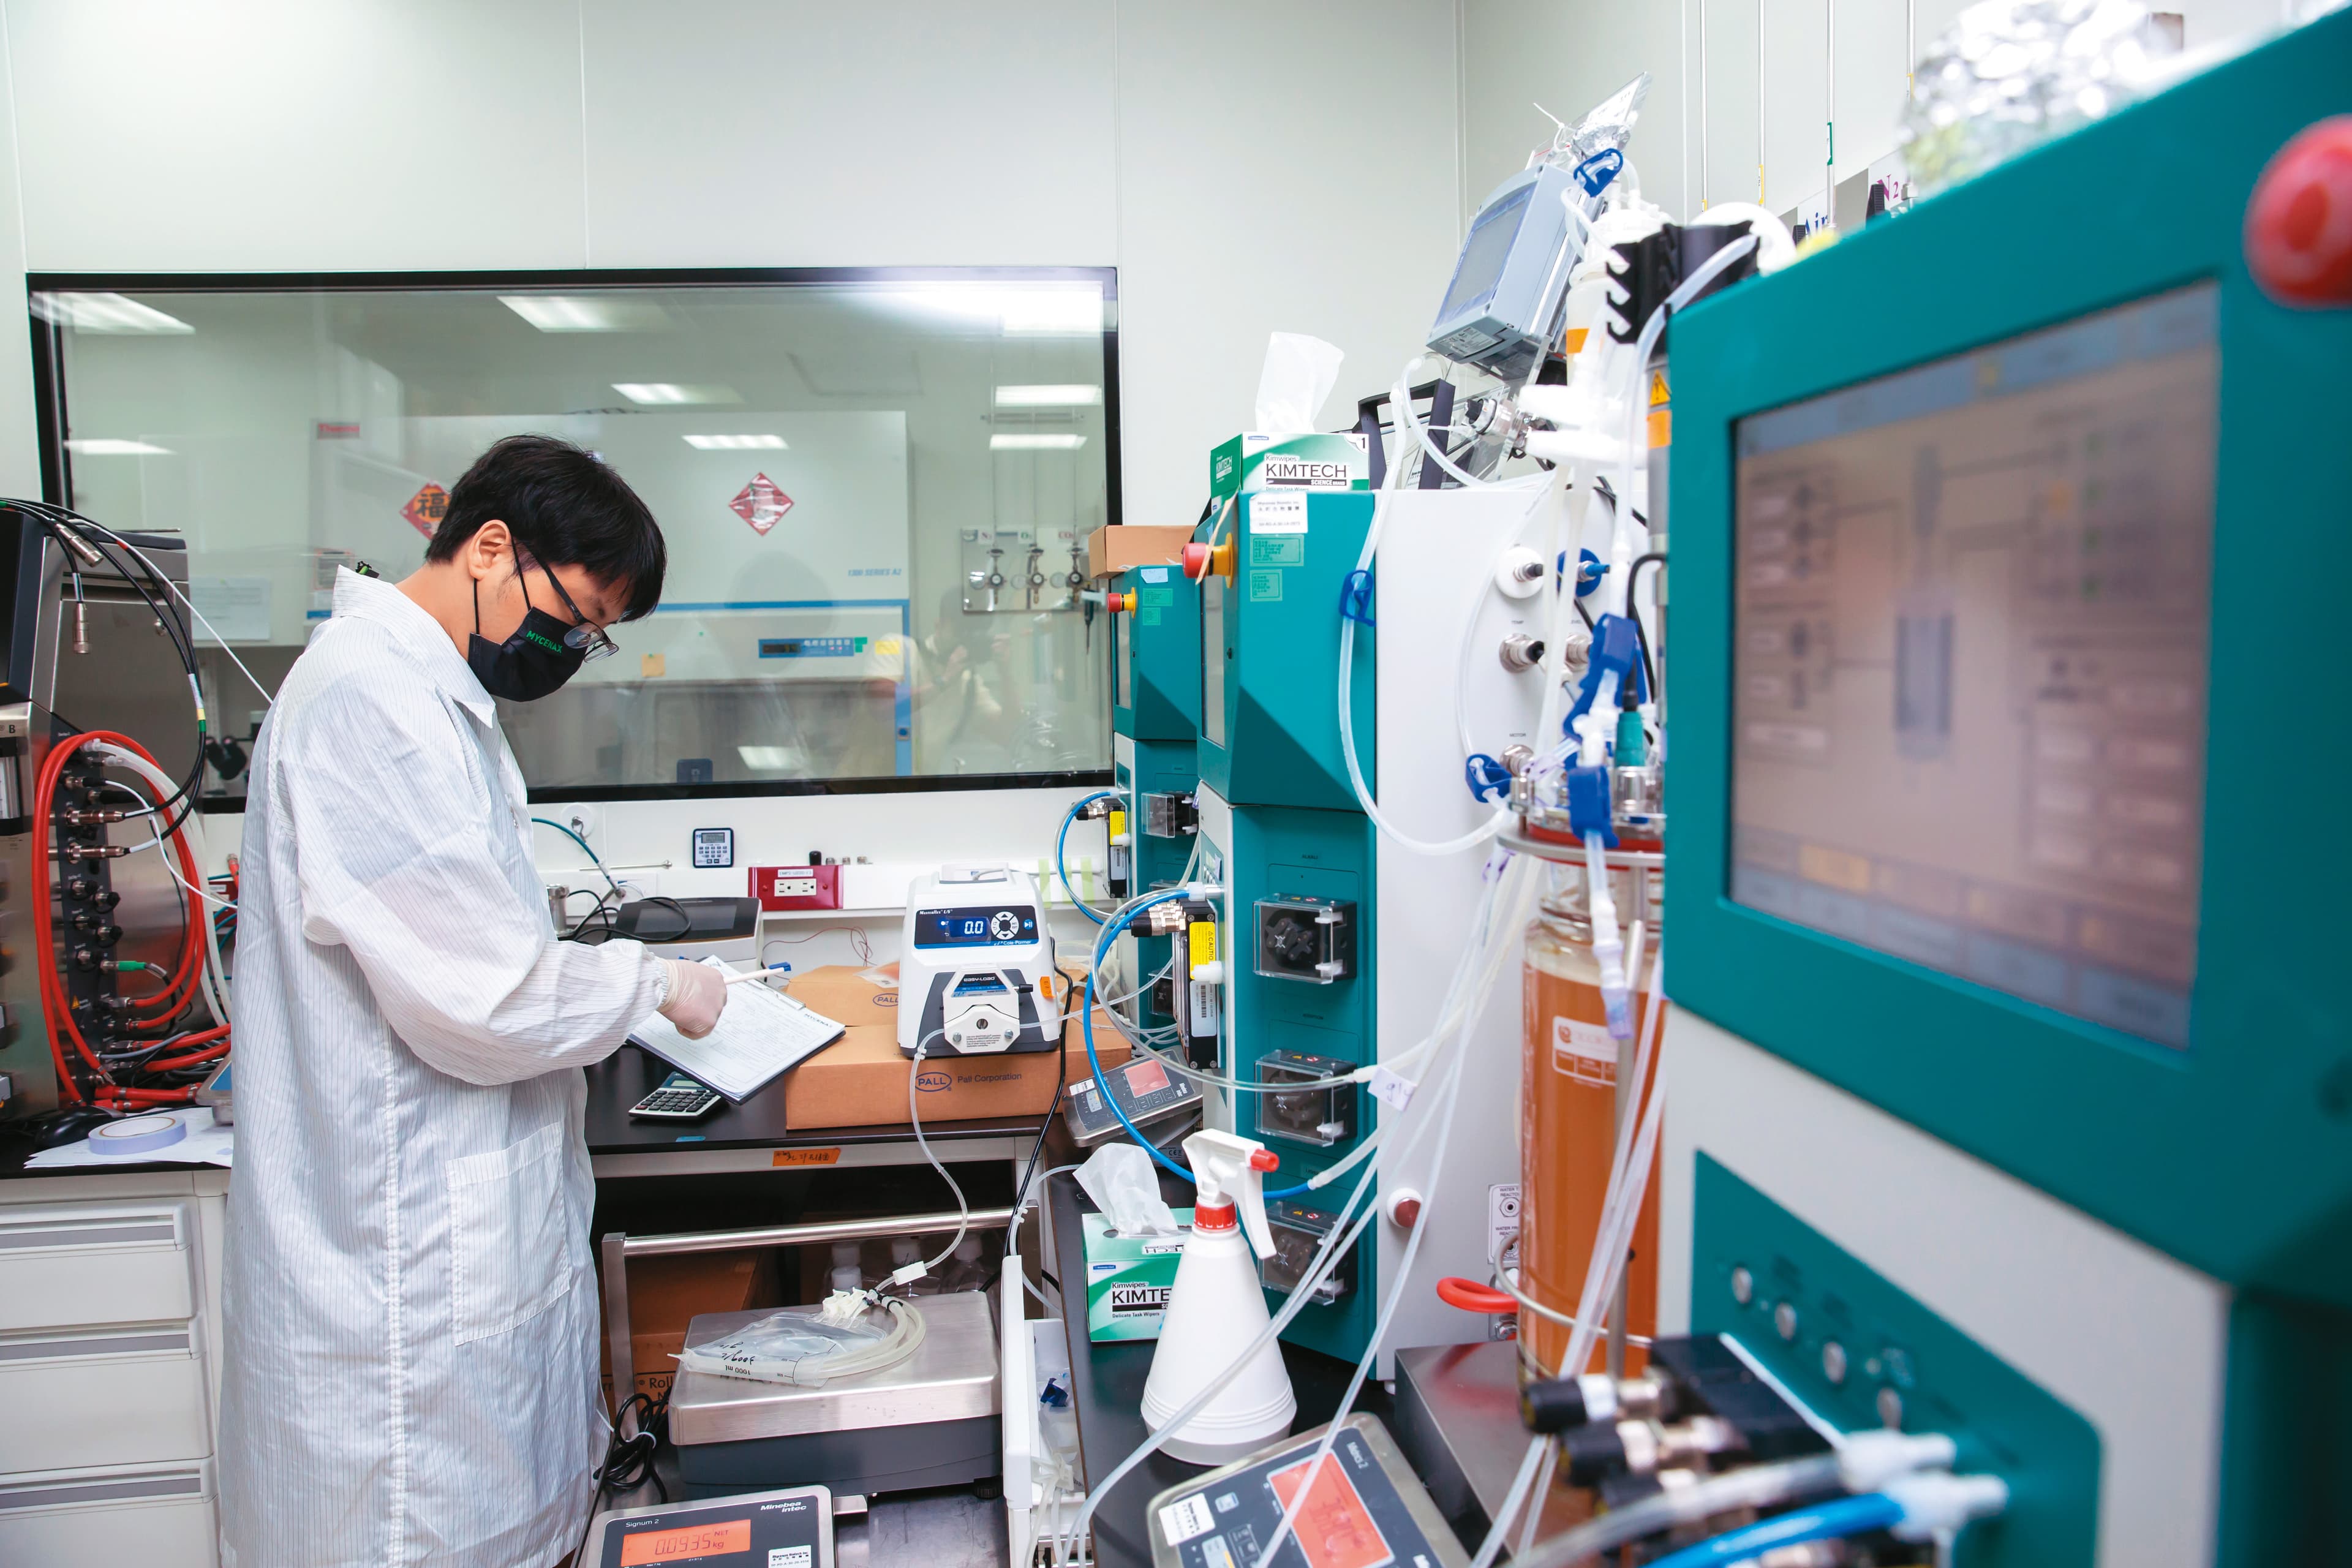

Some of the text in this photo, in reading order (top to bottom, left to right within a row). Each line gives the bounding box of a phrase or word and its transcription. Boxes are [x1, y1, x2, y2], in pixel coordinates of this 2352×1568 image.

[1360, 437, 1366, 449] 1
[1265, 464, 1348, 478] KIMTECH
[414, 492, 447, 519] 福
[526, 630, 563, 654] MYCENAX
[8, 725, 16, 734] B
[964, 921, 984, 935] 0.0
[918, 1076, 947, 1086] PALL
[974, 1073, 1022, 1083] Corporation
[1112, 1288, 1172, 1304] KIMTE
[735, 1367, 752, 1376] 1000
[760, 1501, 802, 1511] Minebea
[781, 1504, 807, 1513] intec
[654, 1533, 725, 1556] 0.0935 kg
